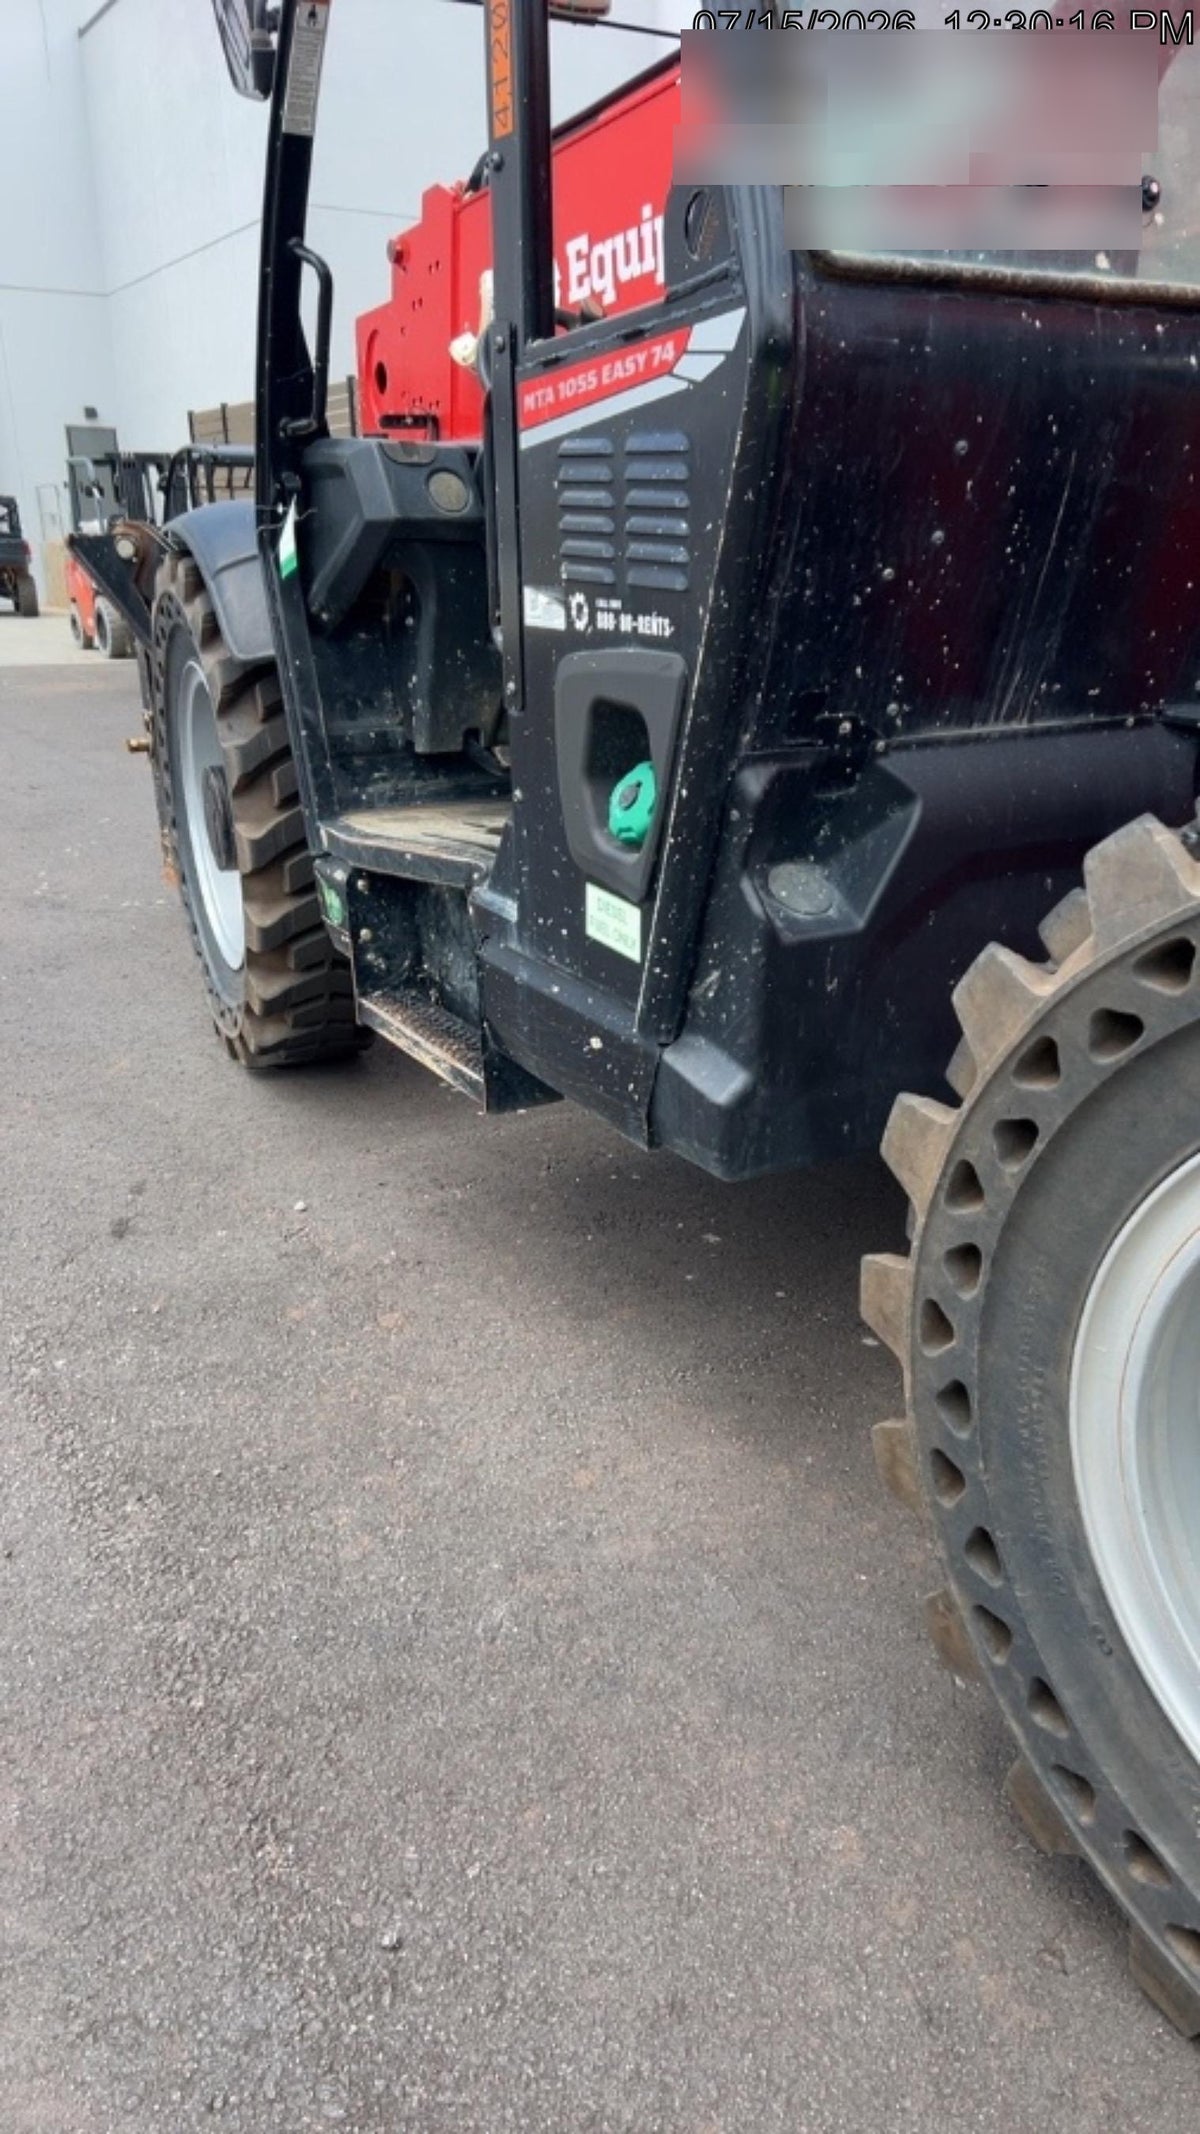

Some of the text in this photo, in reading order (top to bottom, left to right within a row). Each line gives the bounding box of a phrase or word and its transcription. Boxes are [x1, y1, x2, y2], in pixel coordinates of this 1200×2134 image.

[558, 369, 599, 399] 1055
[601, 351, 649, 385] EASY
[652, 340, 676, 368] 74
